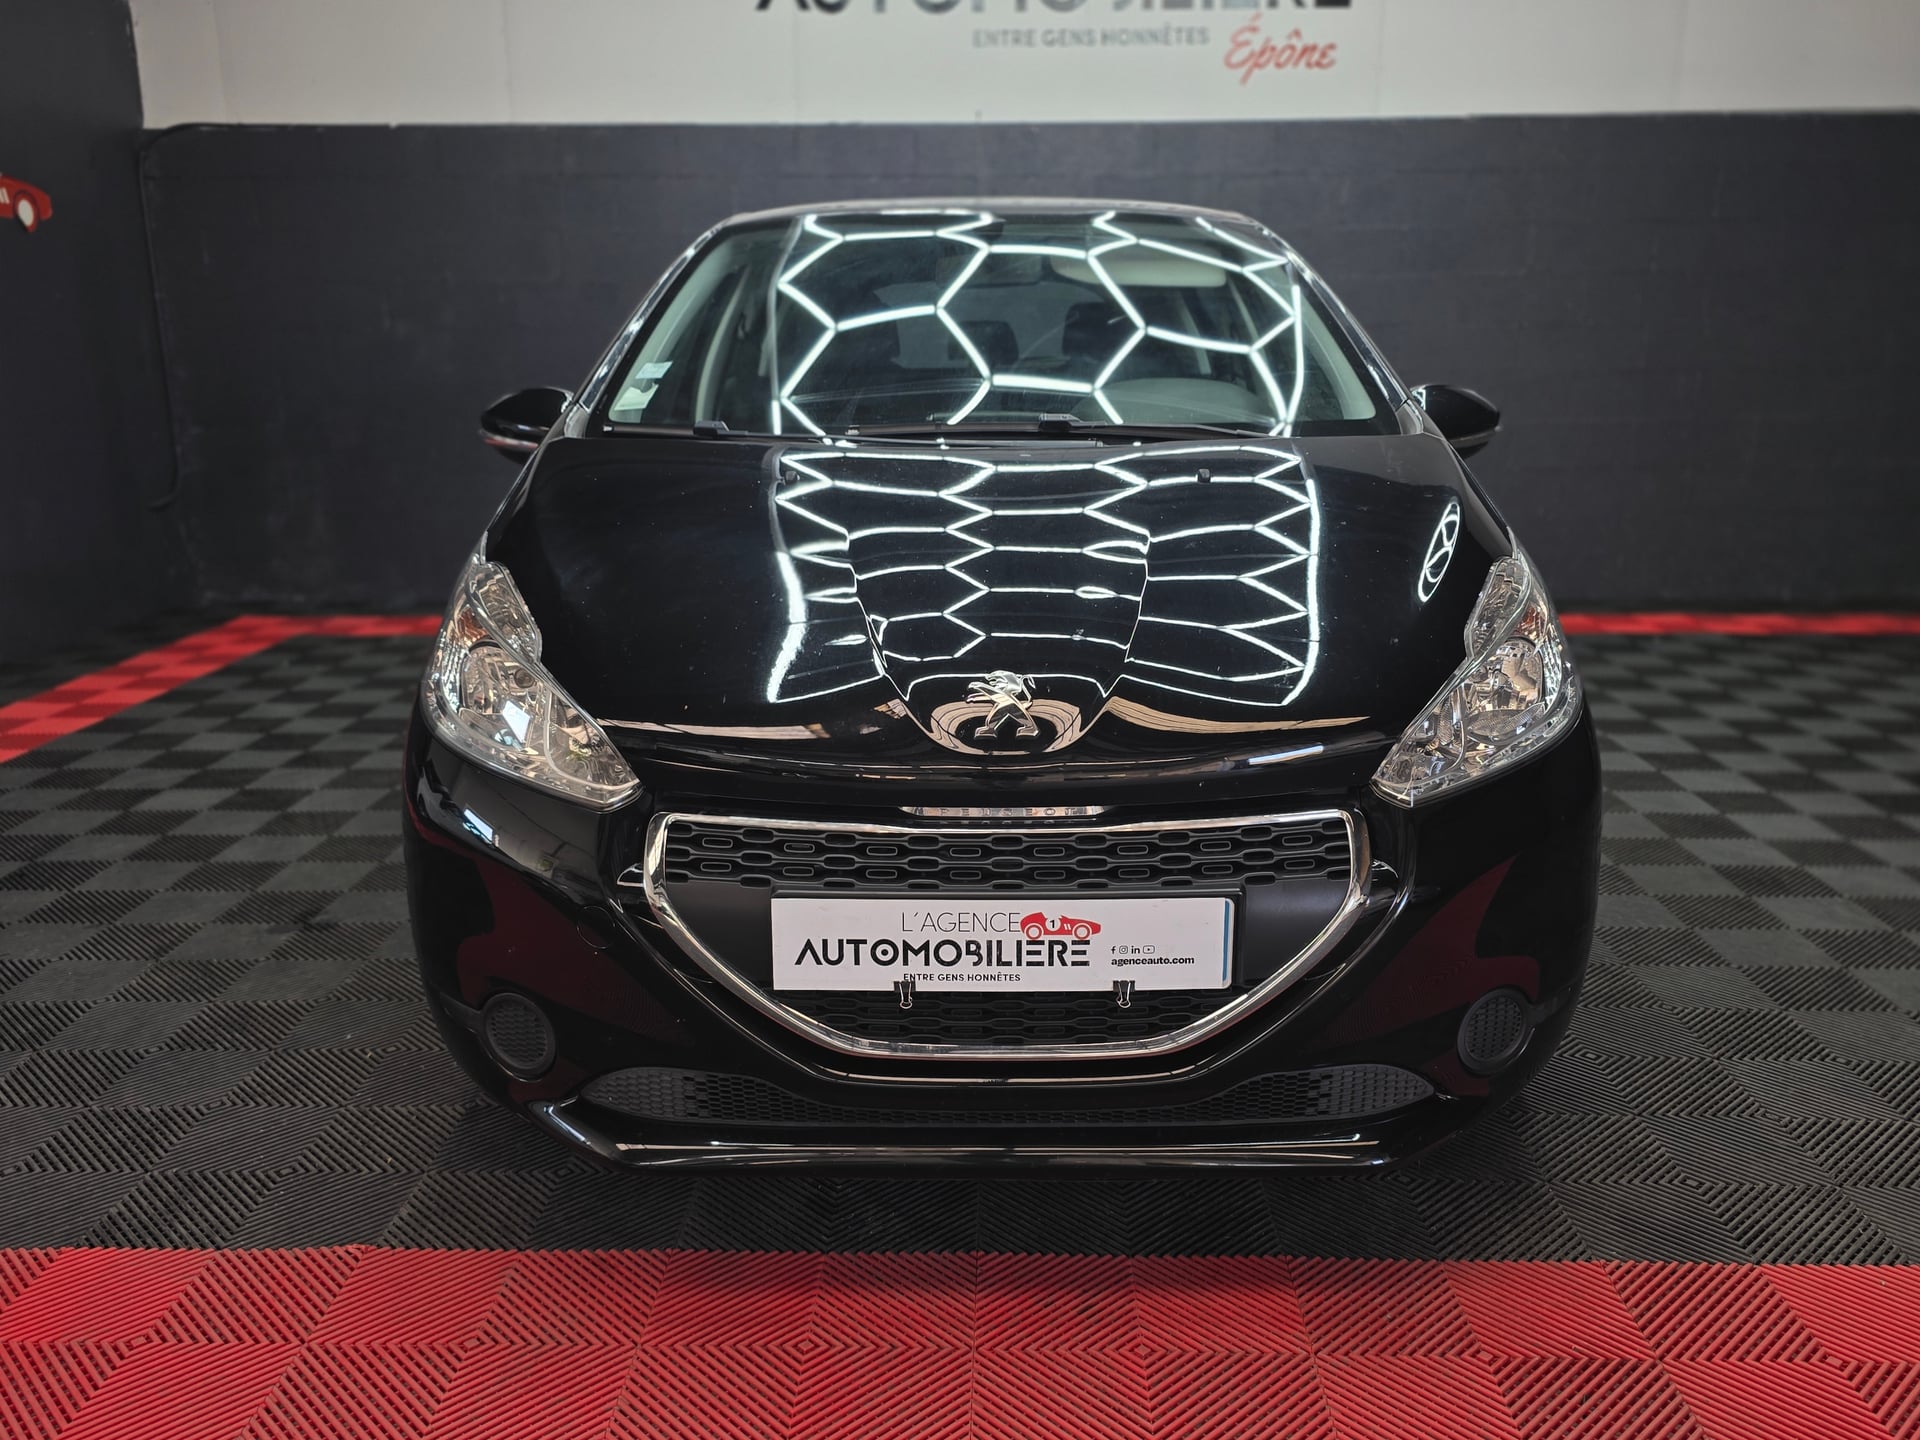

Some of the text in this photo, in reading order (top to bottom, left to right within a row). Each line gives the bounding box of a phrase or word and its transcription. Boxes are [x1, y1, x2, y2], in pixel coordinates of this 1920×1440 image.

[972, 29, 1036, 47] ENTRE
[1041, 28, 1097, 47] GENS
[1223, 12, 1337, 85] Épône
[902, 912, 1021, 932] L'AGENCE
[1111, 957, 1195, 967] agenceauto.com
[903, 971, 1021, 982] ENTRE GENS HONNÊTES
